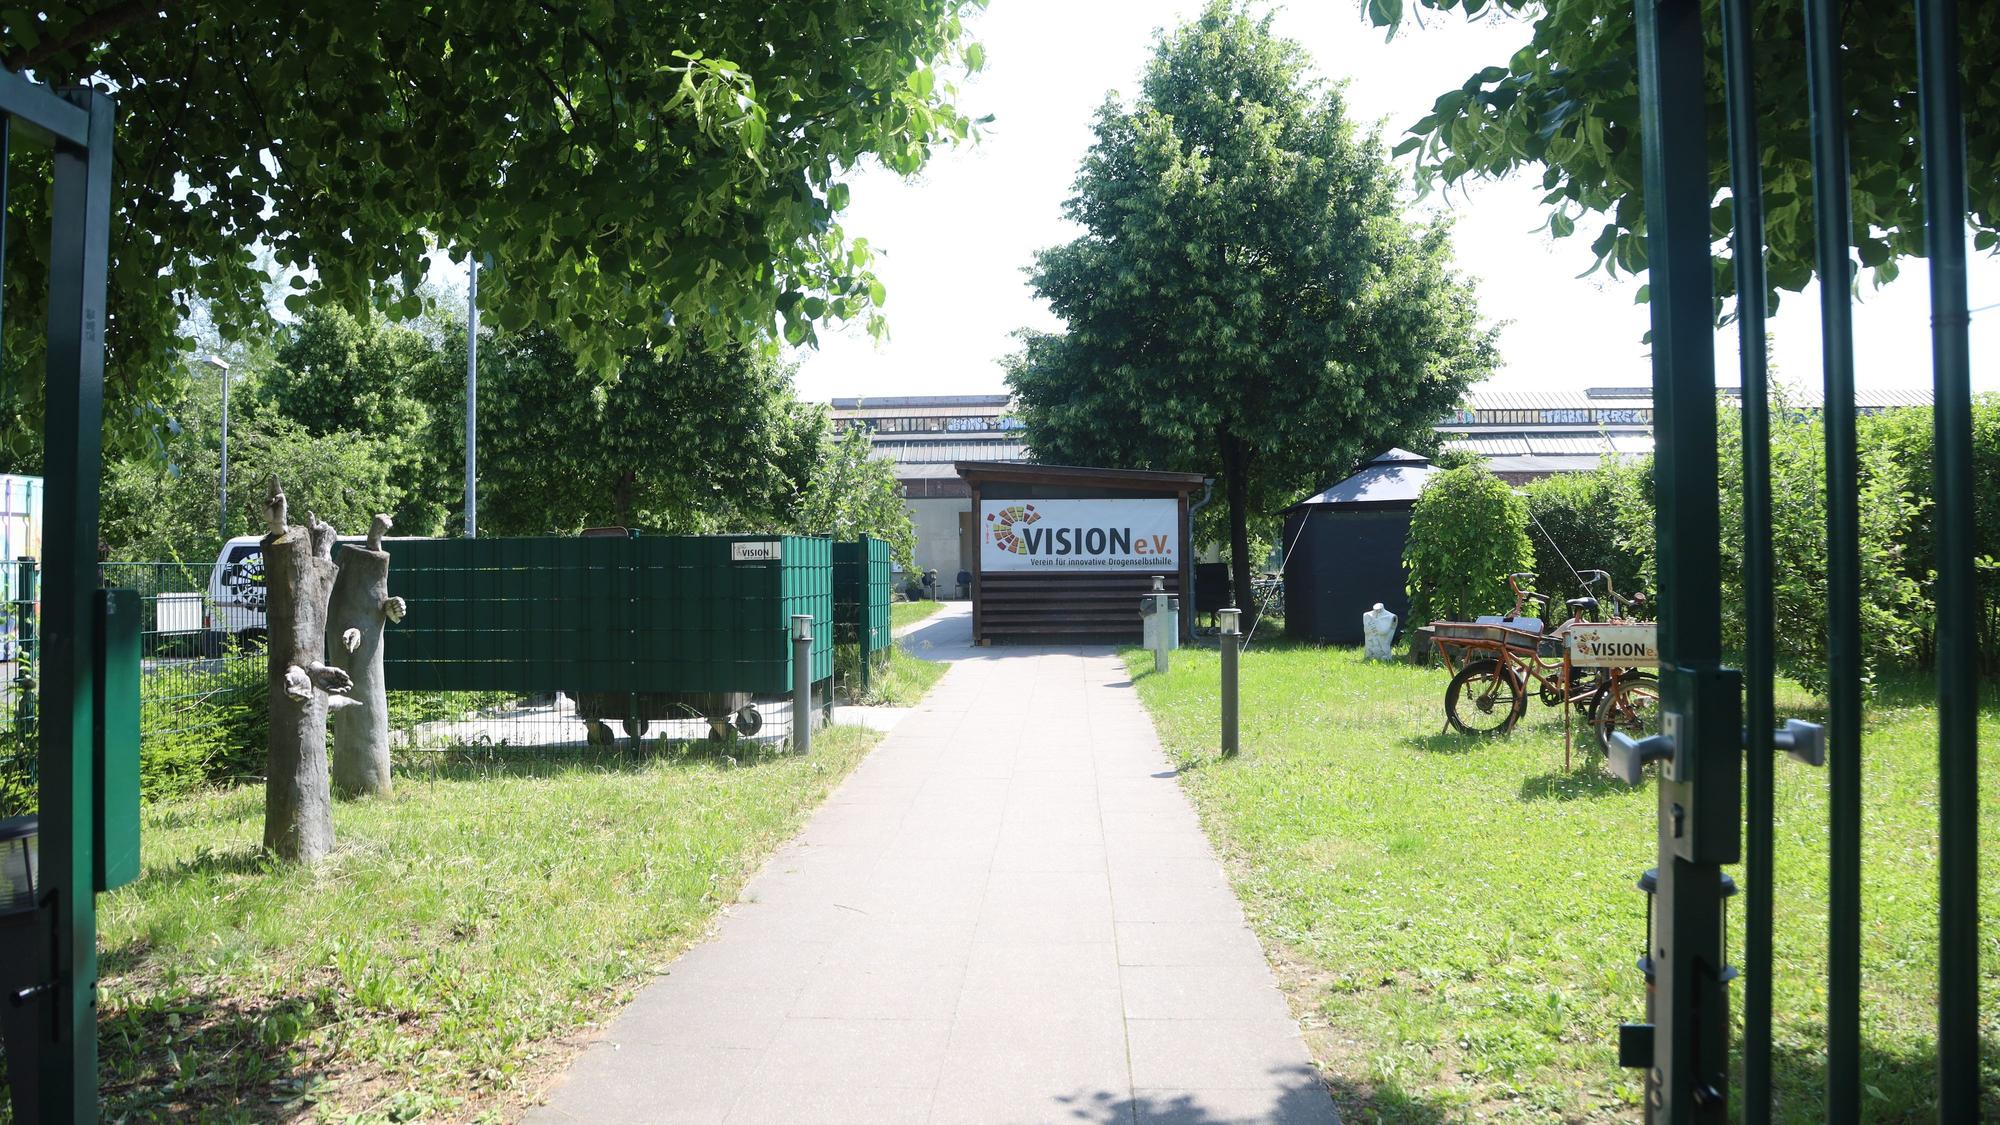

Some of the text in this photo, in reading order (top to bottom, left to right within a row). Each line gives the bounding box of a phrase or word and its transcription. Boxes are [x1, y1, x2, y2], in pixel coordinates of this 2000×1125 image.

[1022, 528, 1172, 555] VISION e.V.
[742, 549, 769, 557] VISION
[1030, 557, 1172, 567] Verein für innovative Drogenselbsthilfe
[1591, 643, 1645, 656] VISION
